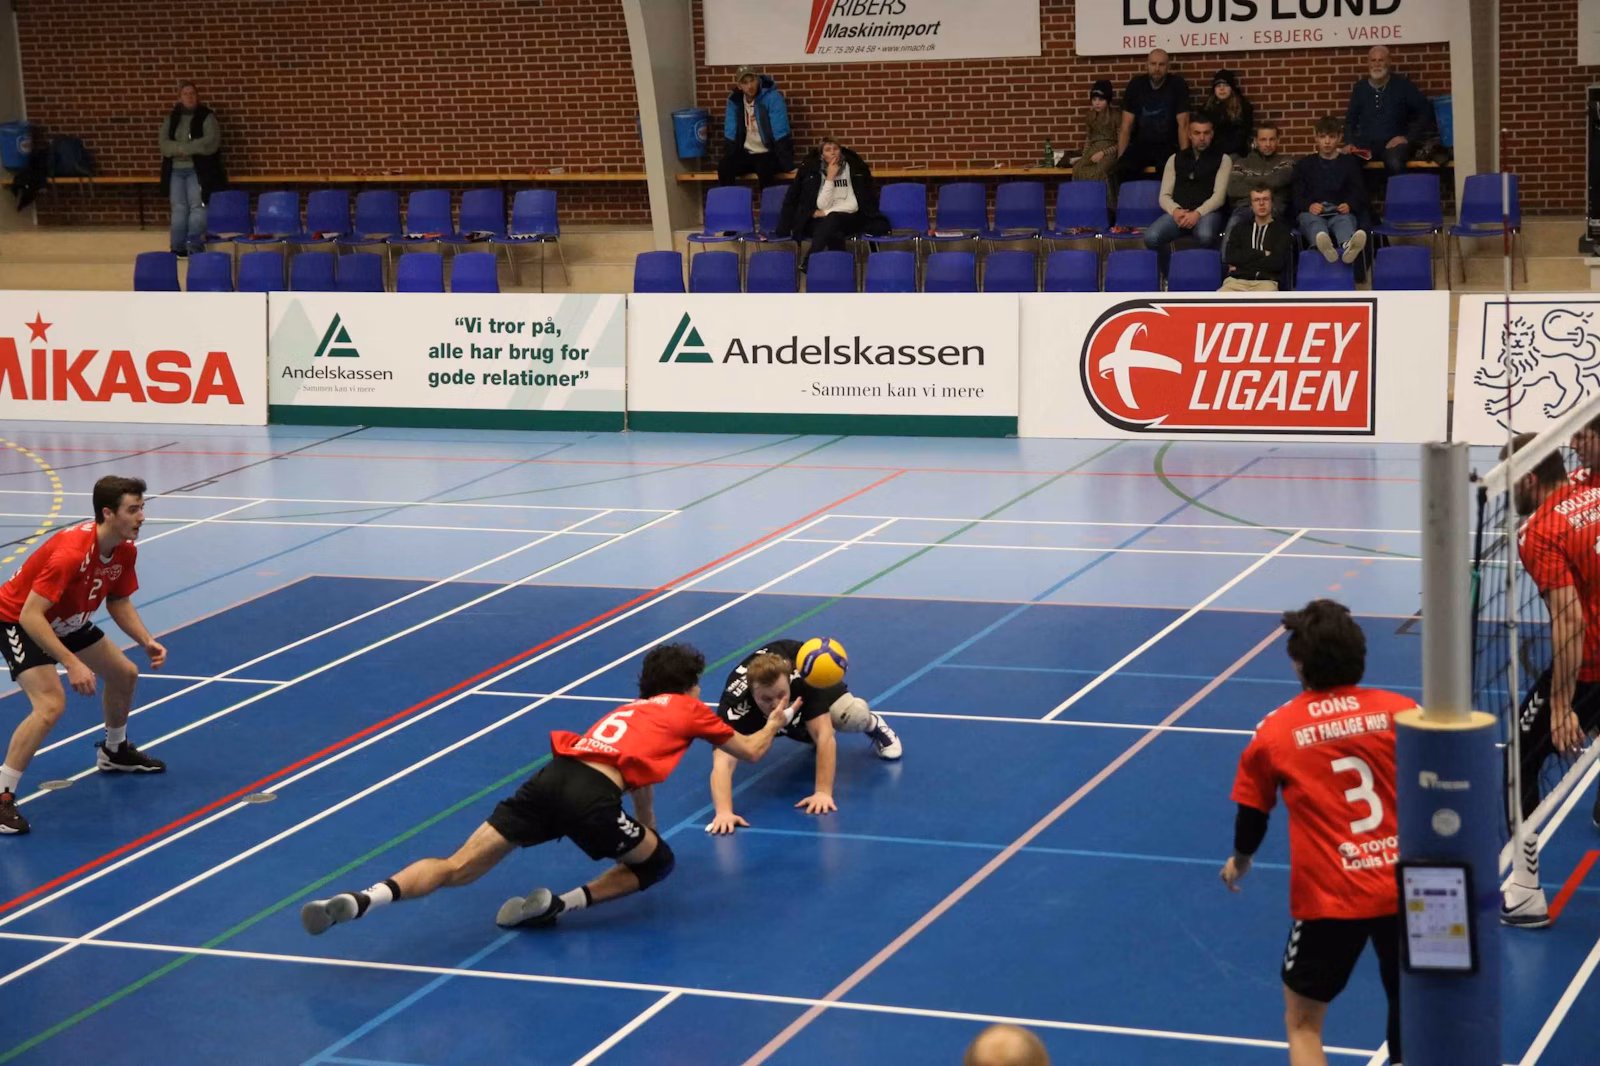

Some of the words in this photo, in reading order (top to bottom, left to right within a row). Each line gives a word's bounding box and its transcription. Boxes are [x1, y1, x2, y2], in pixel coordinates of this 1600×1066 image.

[832, 0, 906, 16] RIBERS
[1122, 0, 1258, 25] LOUIS
[1271, 0, 1400, 19] LUND
[823, 21, 941, 40] Maskinimport
[1122, 35, 1157, 48] RIBE
[1180, 33, 1229, 47] VEJEN
[1253, 28, 1323, 44] ESBJERG
[1348, 25, 1402, 40] VARDE
[488, 318, 525, 333] tror
[532, 316, 561, 337] på,
[428, 343, 464, 359] alle
[470, 343, 503, 359] har
[509, 344, 554, 364] brug
[561, 344, 589, 360] for
[722, 336, 985, 366] Andelskassen
[1194, 322, 1361, 363] VOLLEY
[281, 365, 393, 380] Andelskassen
[428, 369, 475, 388] gode
[302, 385, 333, 393] Sammen
[334, 385, 347, 393] kan
[349, 385, 356, 393] vi
[811, 382, 881, 396] Sammen
[887, 383, 916, 397] kan
[922, 383, 936, 397] vi
[942, 385, 985, 398] mere
[1188, 370, 1359, 411] LIGAEN
[88, 578, 103, 600] 2
[1307, 696, 1360, 718] CONS
[592, 709, 635, 744] 6
[1295, 726, 1317, 746] DET
[1318, 717, 1365, 740] FAGLIGE
[1364, 713, 1389, 731] HUS
[1330, 756, 1384, 834] 3
[1341, 856, 1382, 870] Louis
